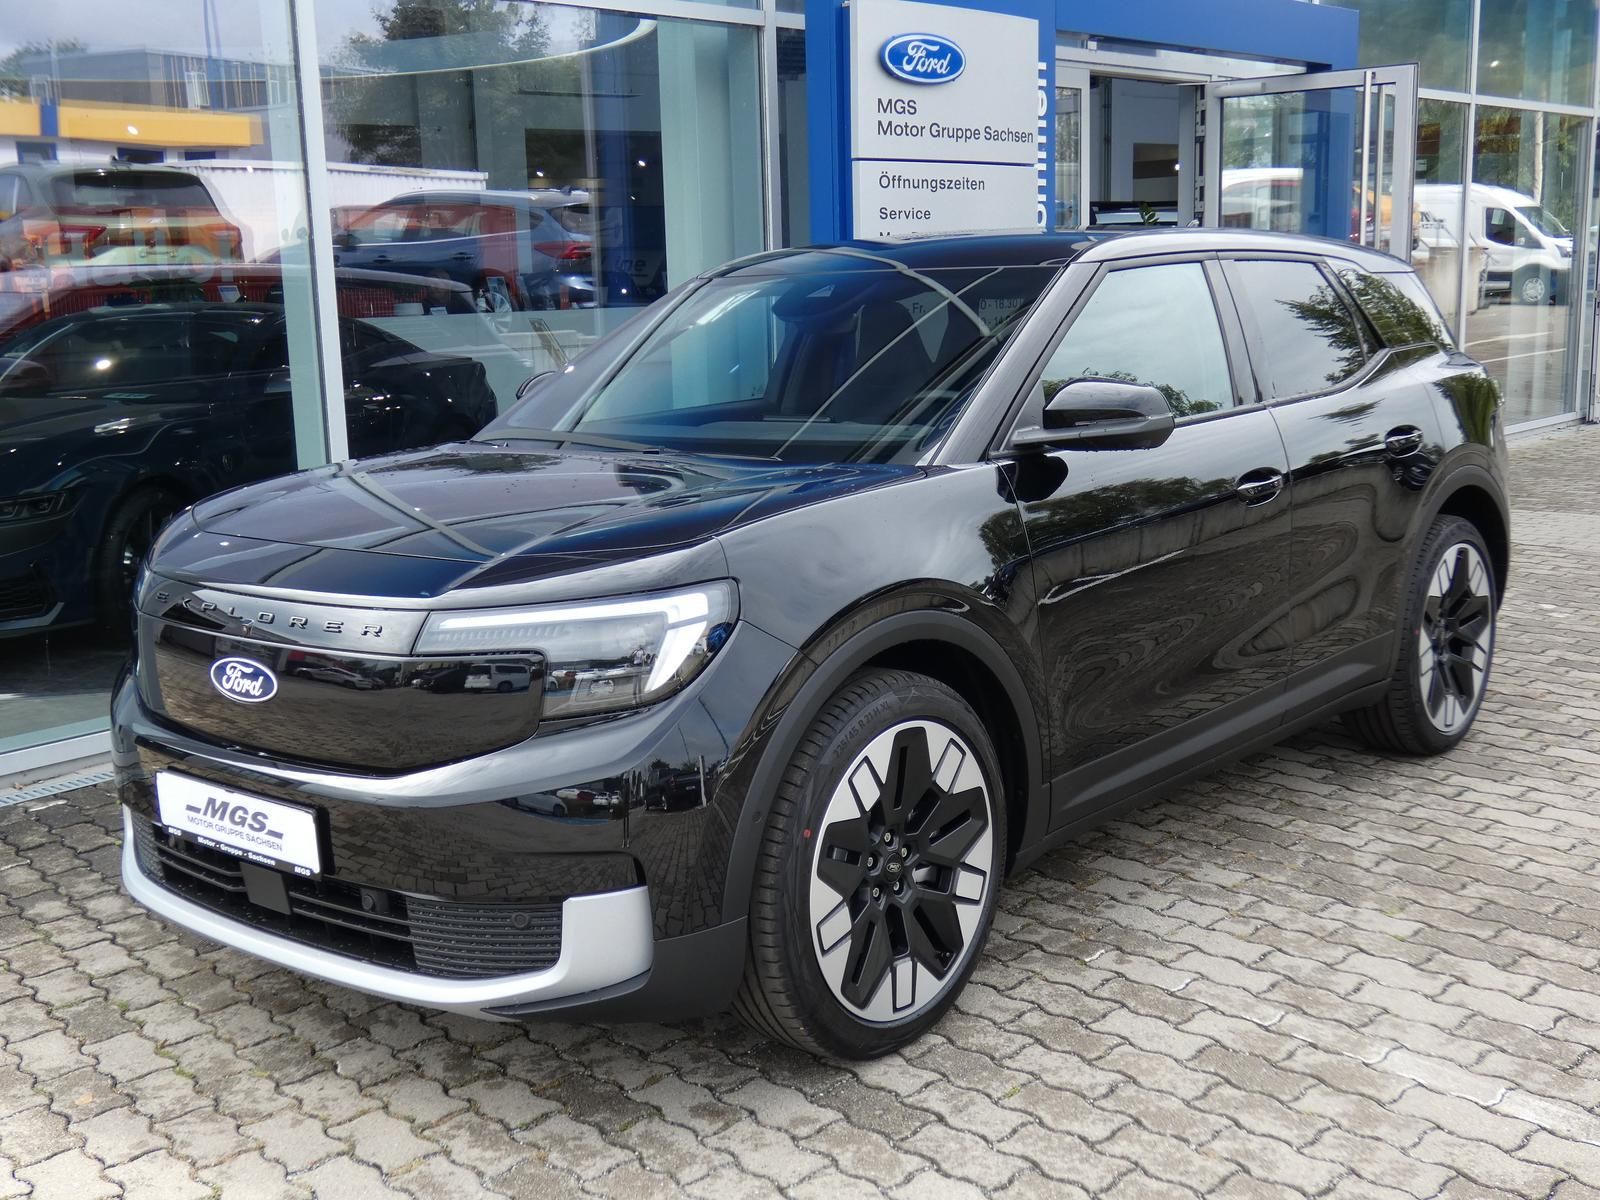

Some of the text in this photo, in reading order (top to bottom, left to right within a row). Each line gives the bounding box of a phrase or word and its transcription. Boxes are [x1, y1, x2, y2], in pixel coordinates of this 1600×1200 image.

[903, 41, 952, 75] Ford
[877, 98, 917, 115] MGS
[877, 120, 1034, 143] Motor Gruppe Sachsen
[879, 171, 985, 192] Öffnungszeiten
[879, 207, 931, 220] Service
[156, 591, 383, 638] EXPLORER
[222, 662, 263, 697] Ford
[187, 815, 283, 851] MOTOR GRUPPE SACHSEN
[294, 865, 311, 876] MGS
